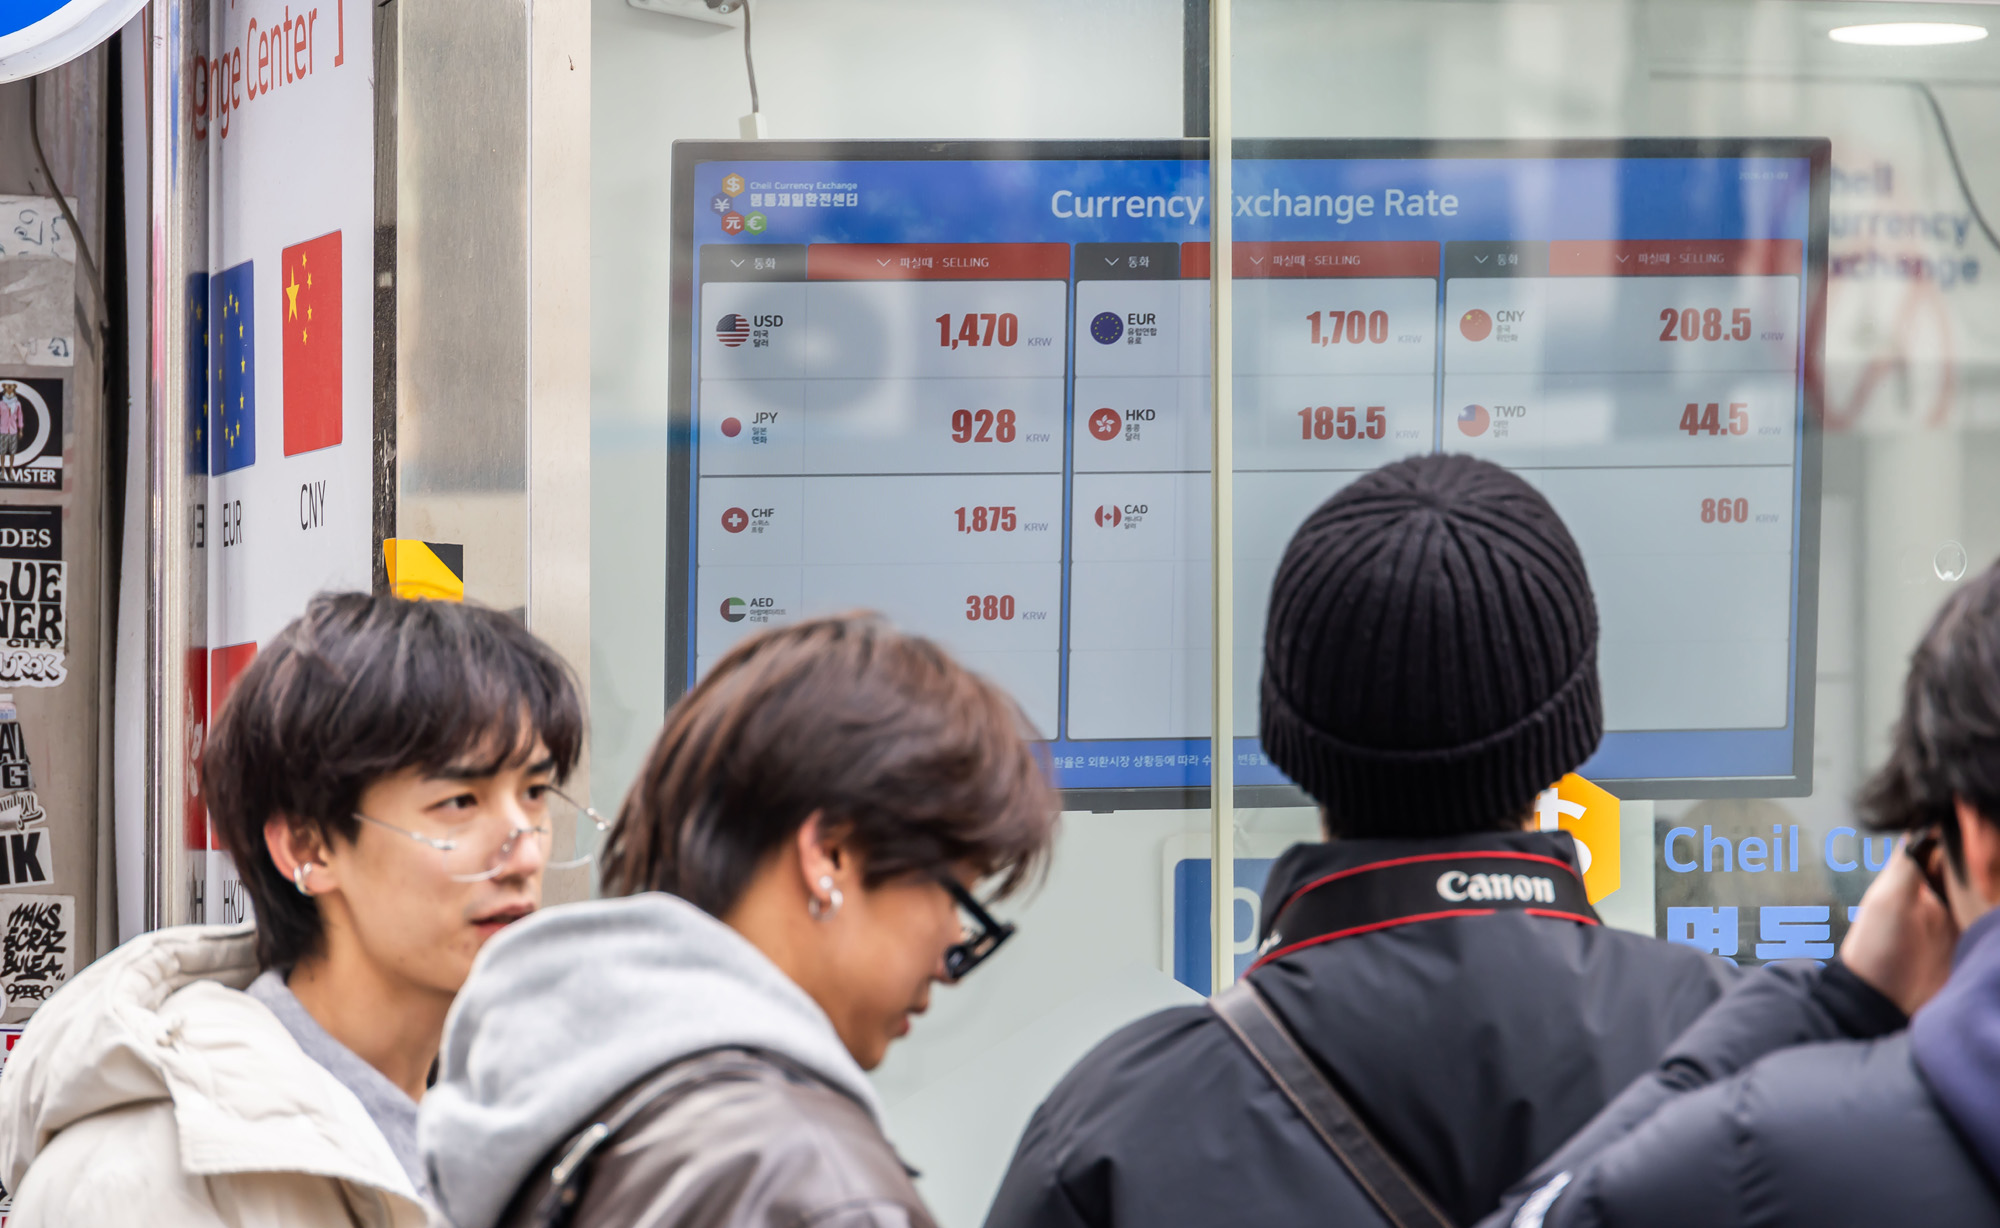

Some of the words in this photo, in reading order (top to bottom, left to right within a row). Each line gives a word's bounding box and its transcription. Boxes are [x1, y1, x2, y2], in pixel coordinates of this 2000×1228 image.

[247, 5, 318, 101] Center
[750, 182, 772, 190] Cheil
[774, 182, 814, 191] Currency
[816, 182, 858, 191] Exchange
[1051, 190, 1205, 225] Currency
[1231, 188, 1374, 224] xchange
[1384, 189, 1459, 217] Rate
[753, 257, 777, 270] 통화
[900, 257, 933, 269] 파실때
[942, 257, 989, 269] SELLING
[1127, 255, 1150, 268] 통화
[1314, 256, 1361, 267] SELLING
[1679, 253, 1725, 264] SELLING
[754, 315, 784, 327] USD
[1128, 313, 1156, 325] EUR
[1496, 310, 1526, 322] CNY
[1306, 310, 1389, 347] 1,700
[1659, 307, 1752, 342] 208.5
[753, 330, 769, 338] 미국
[935, 313, 1019, 350] 1,470
[1027, 337, 1052, 346] KRW
[753, 339, 769, 348] 달러
[752, 412, 778, 424] JPY
[1125, 409, 1156, 421] HKD
[1493, 406, 1526, 418] TWD
[951, 409, 1017, 443] 928
[1025, 434, 1050, 443] KRW
[1298, 406, 1387, 440] 185.5
[1679, 403, 1750, 437] 44.5
[300, 479, 326, 530] CNY
[1124, 504, 1149, 514] CAD
[1700, 497, 1749, 524] 860
[751, 508, 775, 518] CHF
[223, 500, 243, 547] EUR
[954, 506, 1018, 534] 1,875
[1024, 523, 1049, 532] KRW
[750, 597, 774, 608] AED
[965, 594, 1015, 621] 380
[1022, 611, 1048, 620] KRW
[6, 638, 62, 649] CITY
[1664, 824, 1799, 873] Cheil
[1824, 826, 1905, 873] Cu
[1436, 871, 1556, 904] Canon
[222, 879, 245, 924] HKD
